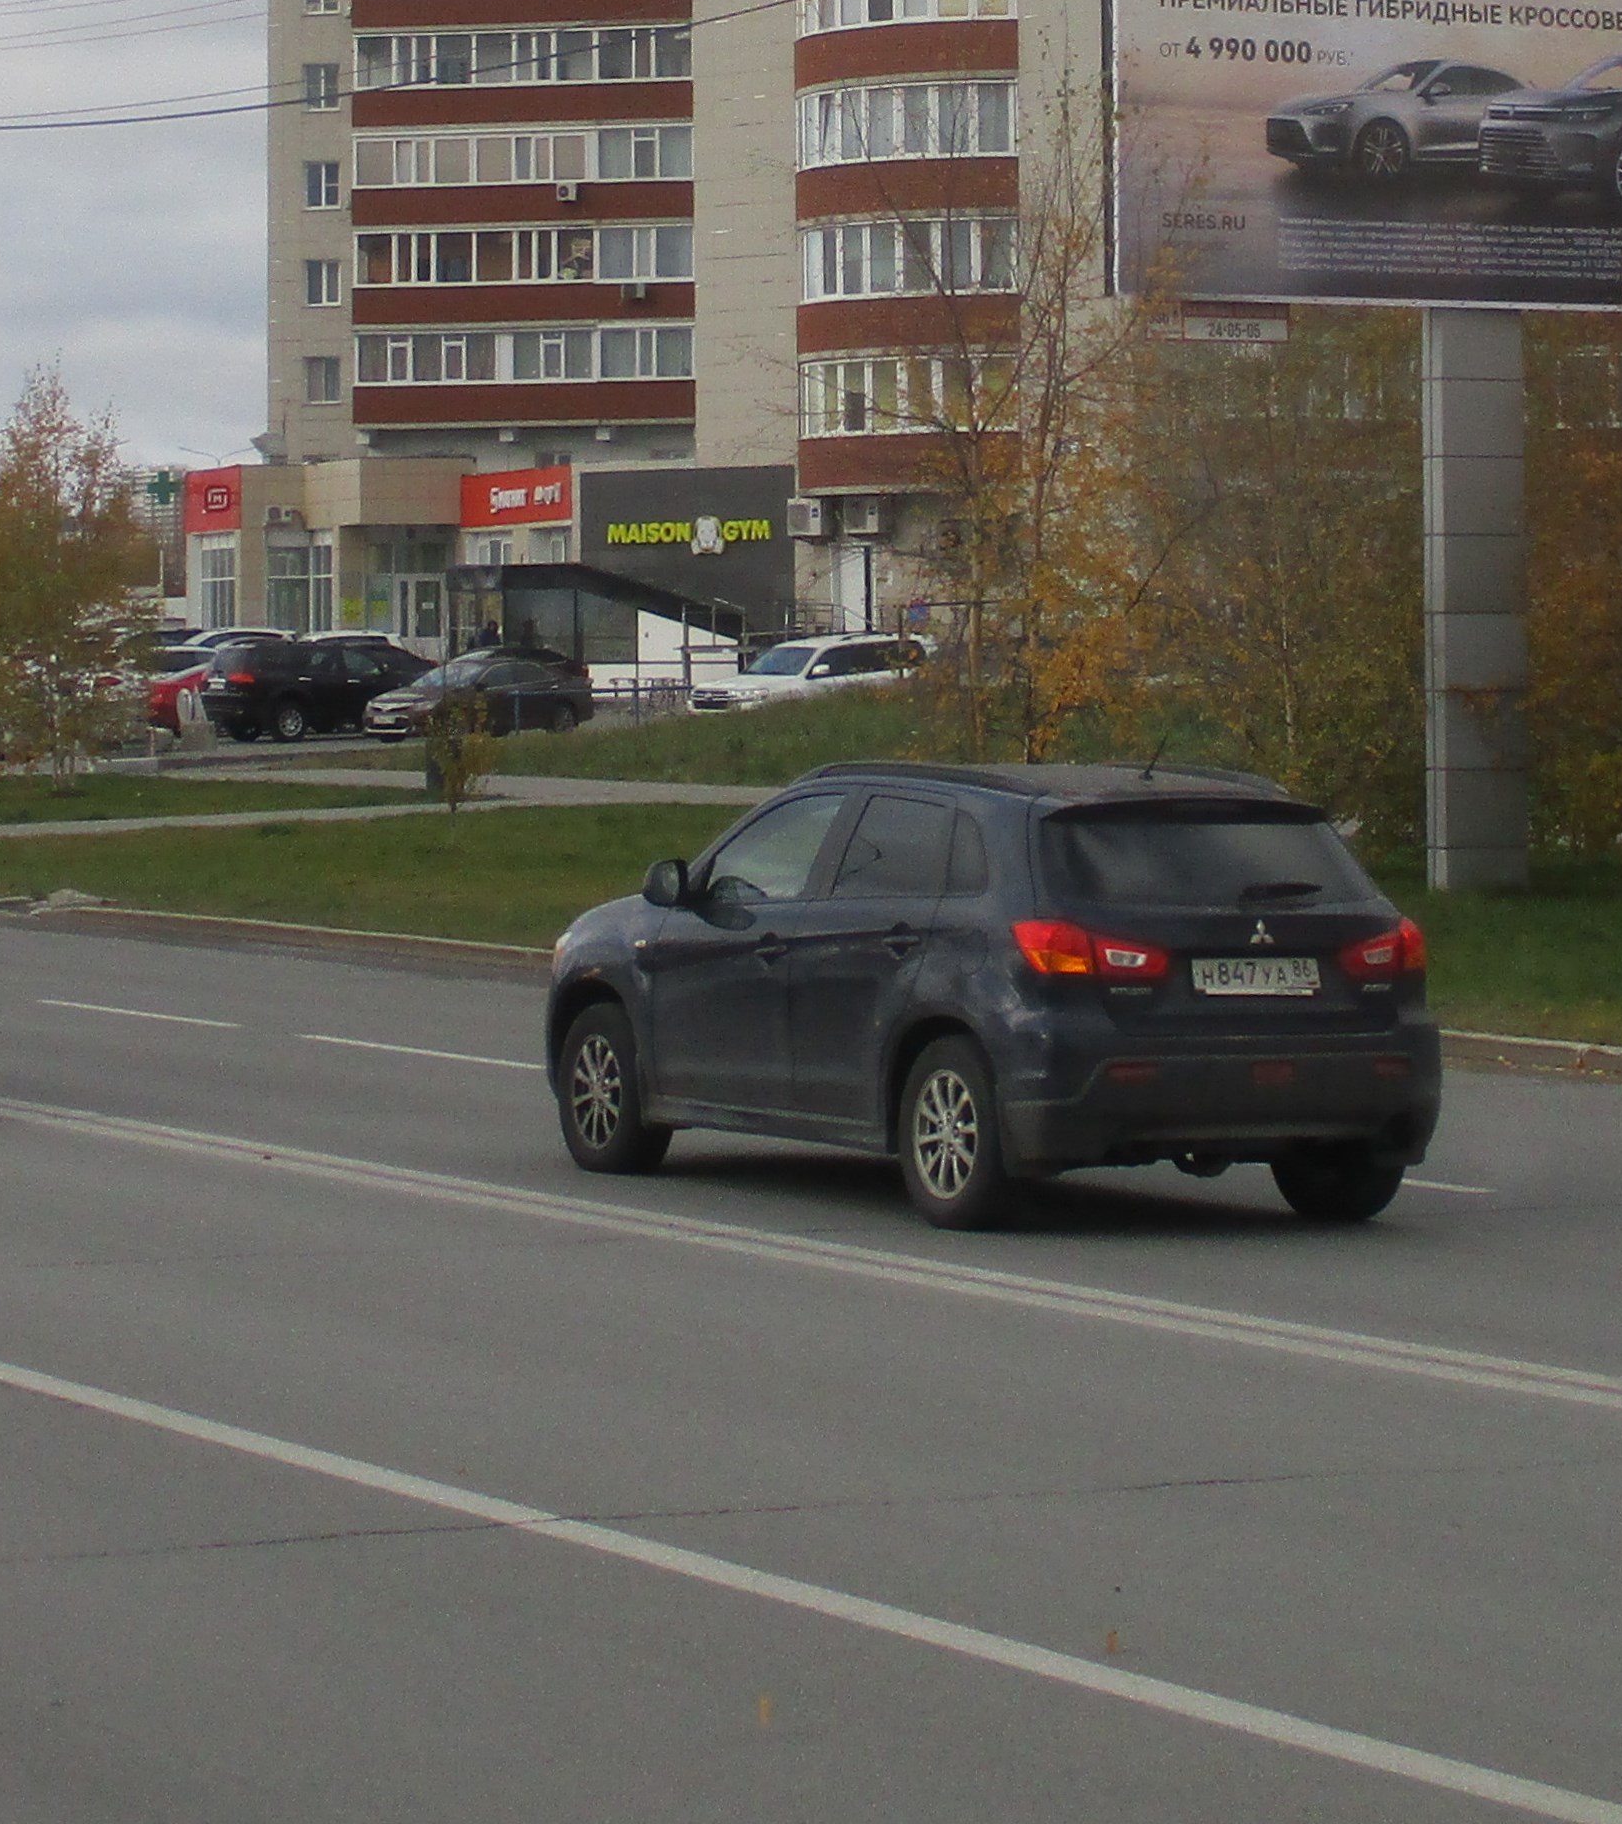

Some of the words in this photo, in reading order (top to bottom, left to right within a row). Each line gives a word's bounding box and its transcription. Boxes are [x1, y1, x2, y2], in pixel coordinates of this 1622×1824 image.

[1159, 42, 1181, 58] ОТ
[1185, 36, 1202, 59] 4
[1208, 37, 1256, 62] 990
[1264, 40, 1312, 63] 000
[1162, 212, 1246, 231] SERES.RU
[607, 522, 691, 545] MAISON
[722, 519, 772, 542] GYM
